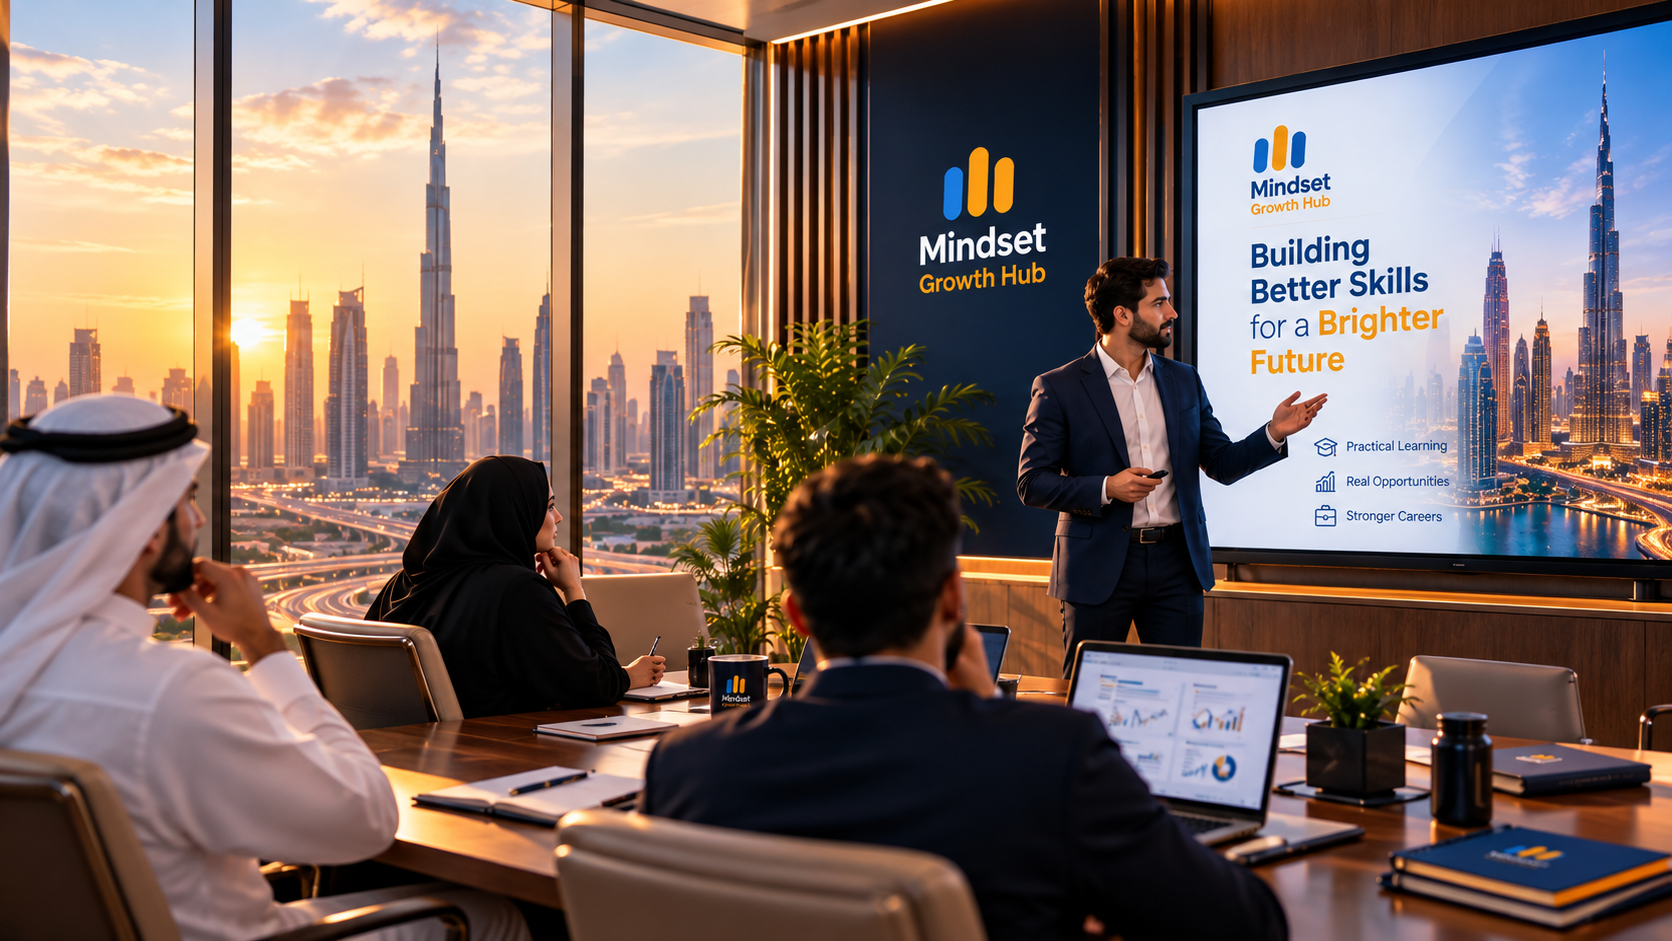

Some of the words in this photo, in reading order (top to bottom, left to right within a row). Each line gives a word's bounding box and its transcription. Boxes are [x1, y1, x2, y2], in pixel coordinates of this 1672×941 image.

[1250, 173, 1330, 199] Mindset
[1250, 197, 1299, 215] Growth
[1303, 194, 1330, 210] Hub
[919, 222, 1046, 265] Mindset
[1251, 235, 1369, 268] Building
[919, 267, 995, 294] Growth
[1001, 261, 1046, 286] Hub
[1251, 275, 1341, 304] Better
[1349, 266, 1429, 297] Skills
[1250, 314, 1287, 339] for
[1294, 318, 1309, 337] a
[1319, 305, 1443, 340] Brighter
[1251, 349, 1345, 375] Future
[1346, 440, 1395, 451] Practical
[1398, 439, 1447, 453] Learning
[1346, 475, 1370, 486] Real
[1372, 475, 1449, 488] Opportunities
[1346, 509, 1395, 523] Stronger
[1398, 510, 1443, 522] Careers
